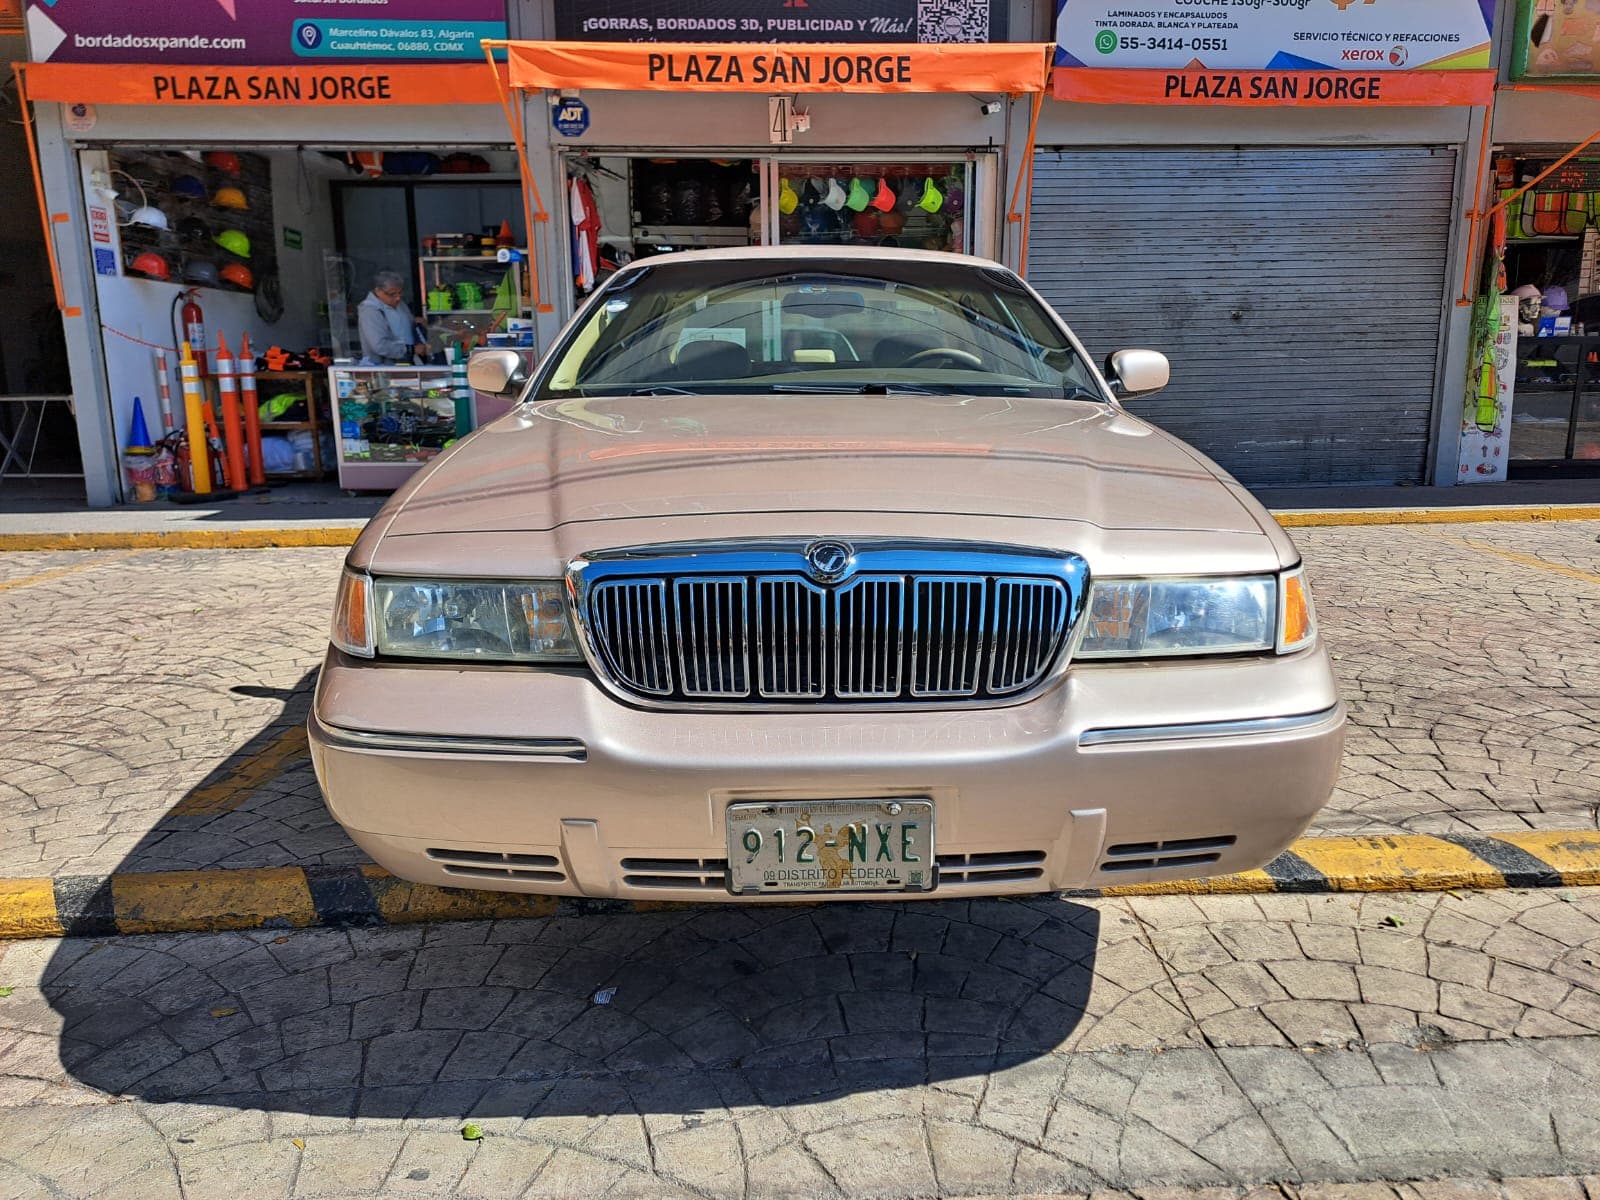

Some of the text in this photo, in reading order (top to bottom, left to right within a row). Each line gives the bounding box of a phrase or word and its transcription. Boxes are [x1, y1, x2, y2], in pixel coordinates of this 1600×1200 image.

[1107, 10, 1155, 18] LAMINADOS
[1163, 11, 1228, 19] ENCAPSALUDOS
[583, 17, 914, 34] ¡GORRAS, BORDADOS 3D, PUBLICIDAD Y Más!
[1095, 20, 1118, 28] TINTA
[1157, 21, 1190, 29] BLANCA
[329, 28, 378, 37] Marcelino
[420, 29, 436, 39] 83,
[1293, 31, 1460, 42] SERVICIO TÉCNICO Y REFACCIONES
[74, 33, 247, 51] bordadosxpande.com
[397, 42, 432, 52] 06880,
[433, 42, 464, 52] CDMX
[1119, 36, 1228, 51] 55-3414-0551
[1341, 49, 1385, 61] xerox
[648, 54, 911, 84] PLAZA SAN JORGE
[153, 75, 391, 100] PLAZA SAN JORGE
[1164, 75, 1381, 101] PLAZA SAN JORGE
[559, 107, 584, 121] ADT
[772, 98, 788, 142] 4
[742, 822, 922, 864] 912-NXE
[763, 867, 901, 881] 09 DISTRITO FEDERAL
